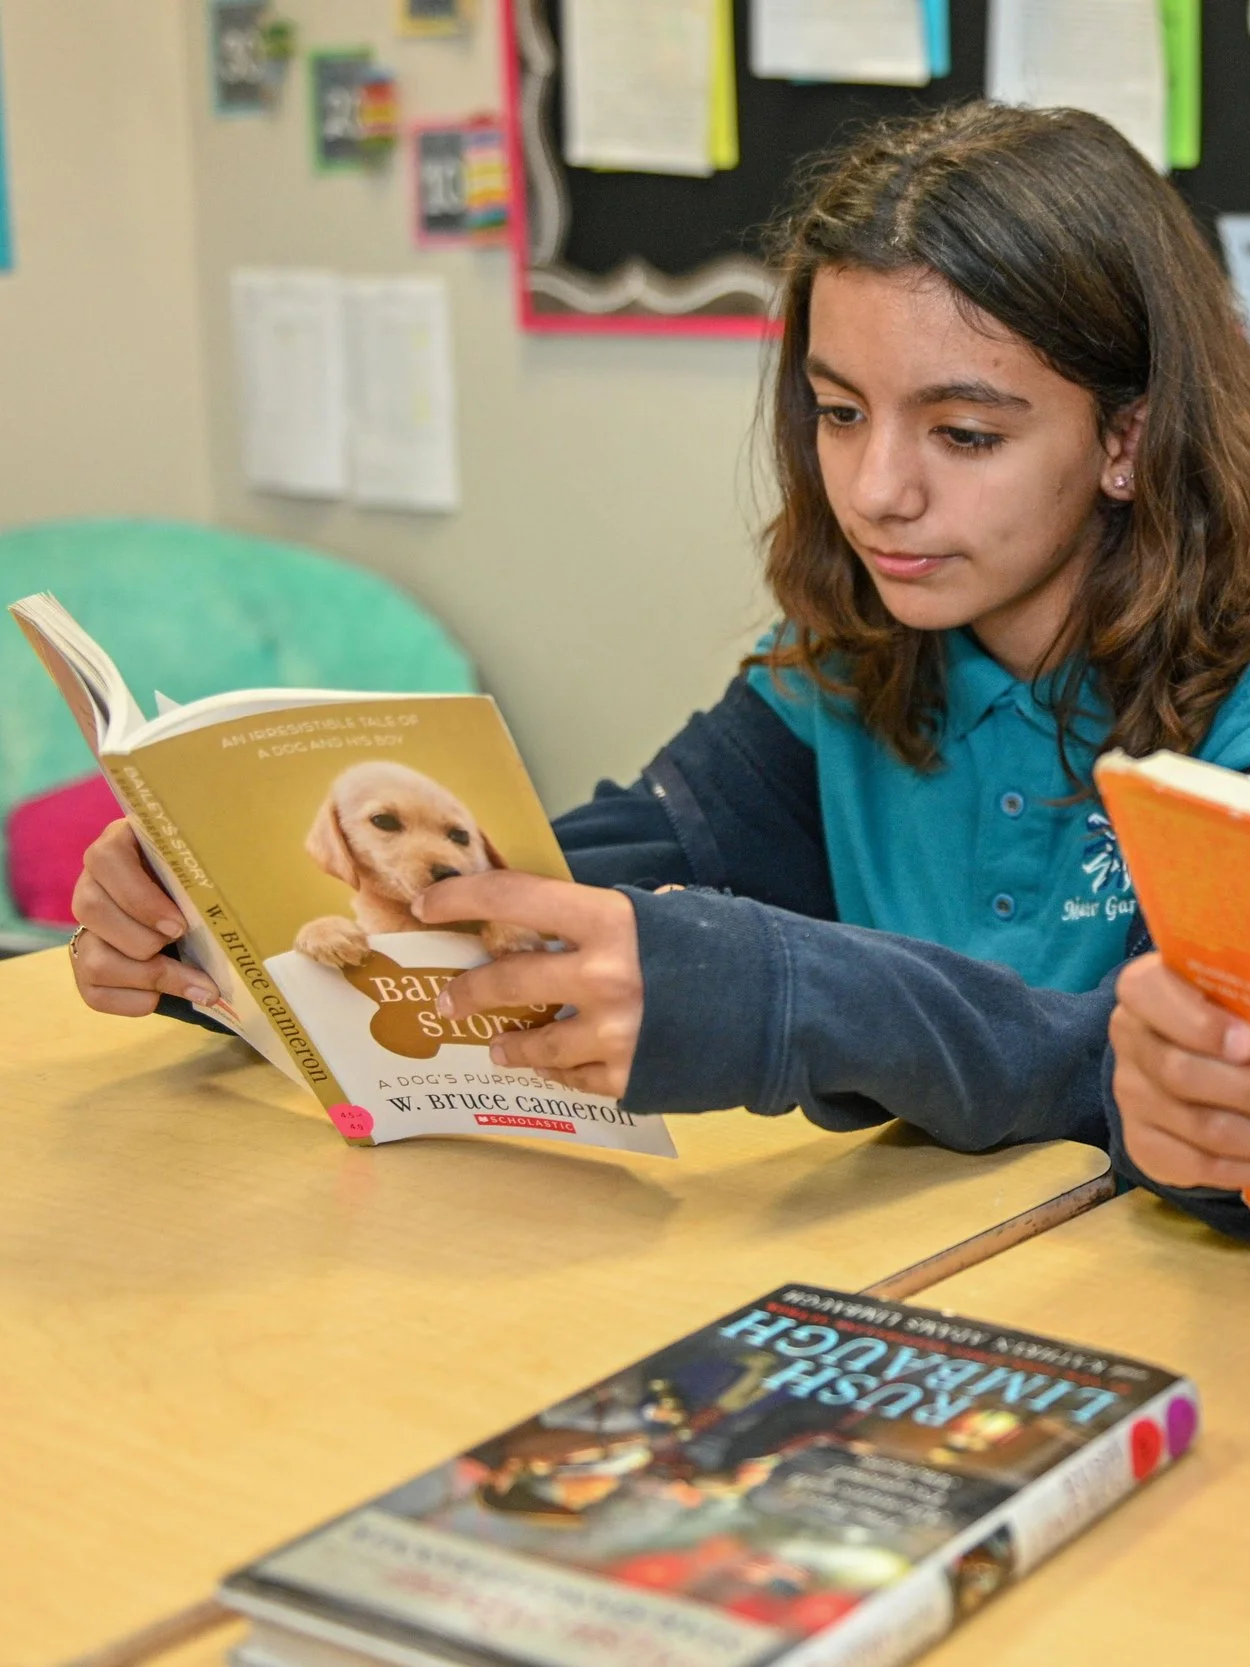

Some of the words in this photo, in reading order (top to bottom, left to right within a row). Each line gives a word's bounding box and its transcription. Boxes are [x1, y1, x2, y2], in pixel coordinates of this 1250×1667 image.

[221, 734, 246, 750] AN
[248, 716, 354, 742] IRRESISTIBLE
[358, 714, 394, 729] TALE
[397, 713, 420, 727] OF
[258, 747, 271, 760] A
[272, 741, 307, 757] DOG
[309, 737, 343, 750] AND
[346, 735, 373, 748] HIS
[374, 734, 404, 747] BOY
[123, 765, 178, 836] BAILEY'S
[170, 839, 214, 889] STORY
[205, 903, 229, 926] W.
[220, 928, 270, 990] Bruce
[379, 1079, 392, 1090] A
[397, 1073, 458, 1087] DOG'S
[464, 1073, 555, 1090] PURPOSE
[386, 1096, 421, 1113] W.
[425, 1093, 509, 1111] Bruce
[490, 1115, 574, 1132] SCHOLASTIC
[781, 1288, 903, 1327] LIMBAUGH
[717, 1307, 1119, 1425] LIMBAUGH
[760, 1359, 975, 1428] RUSH
